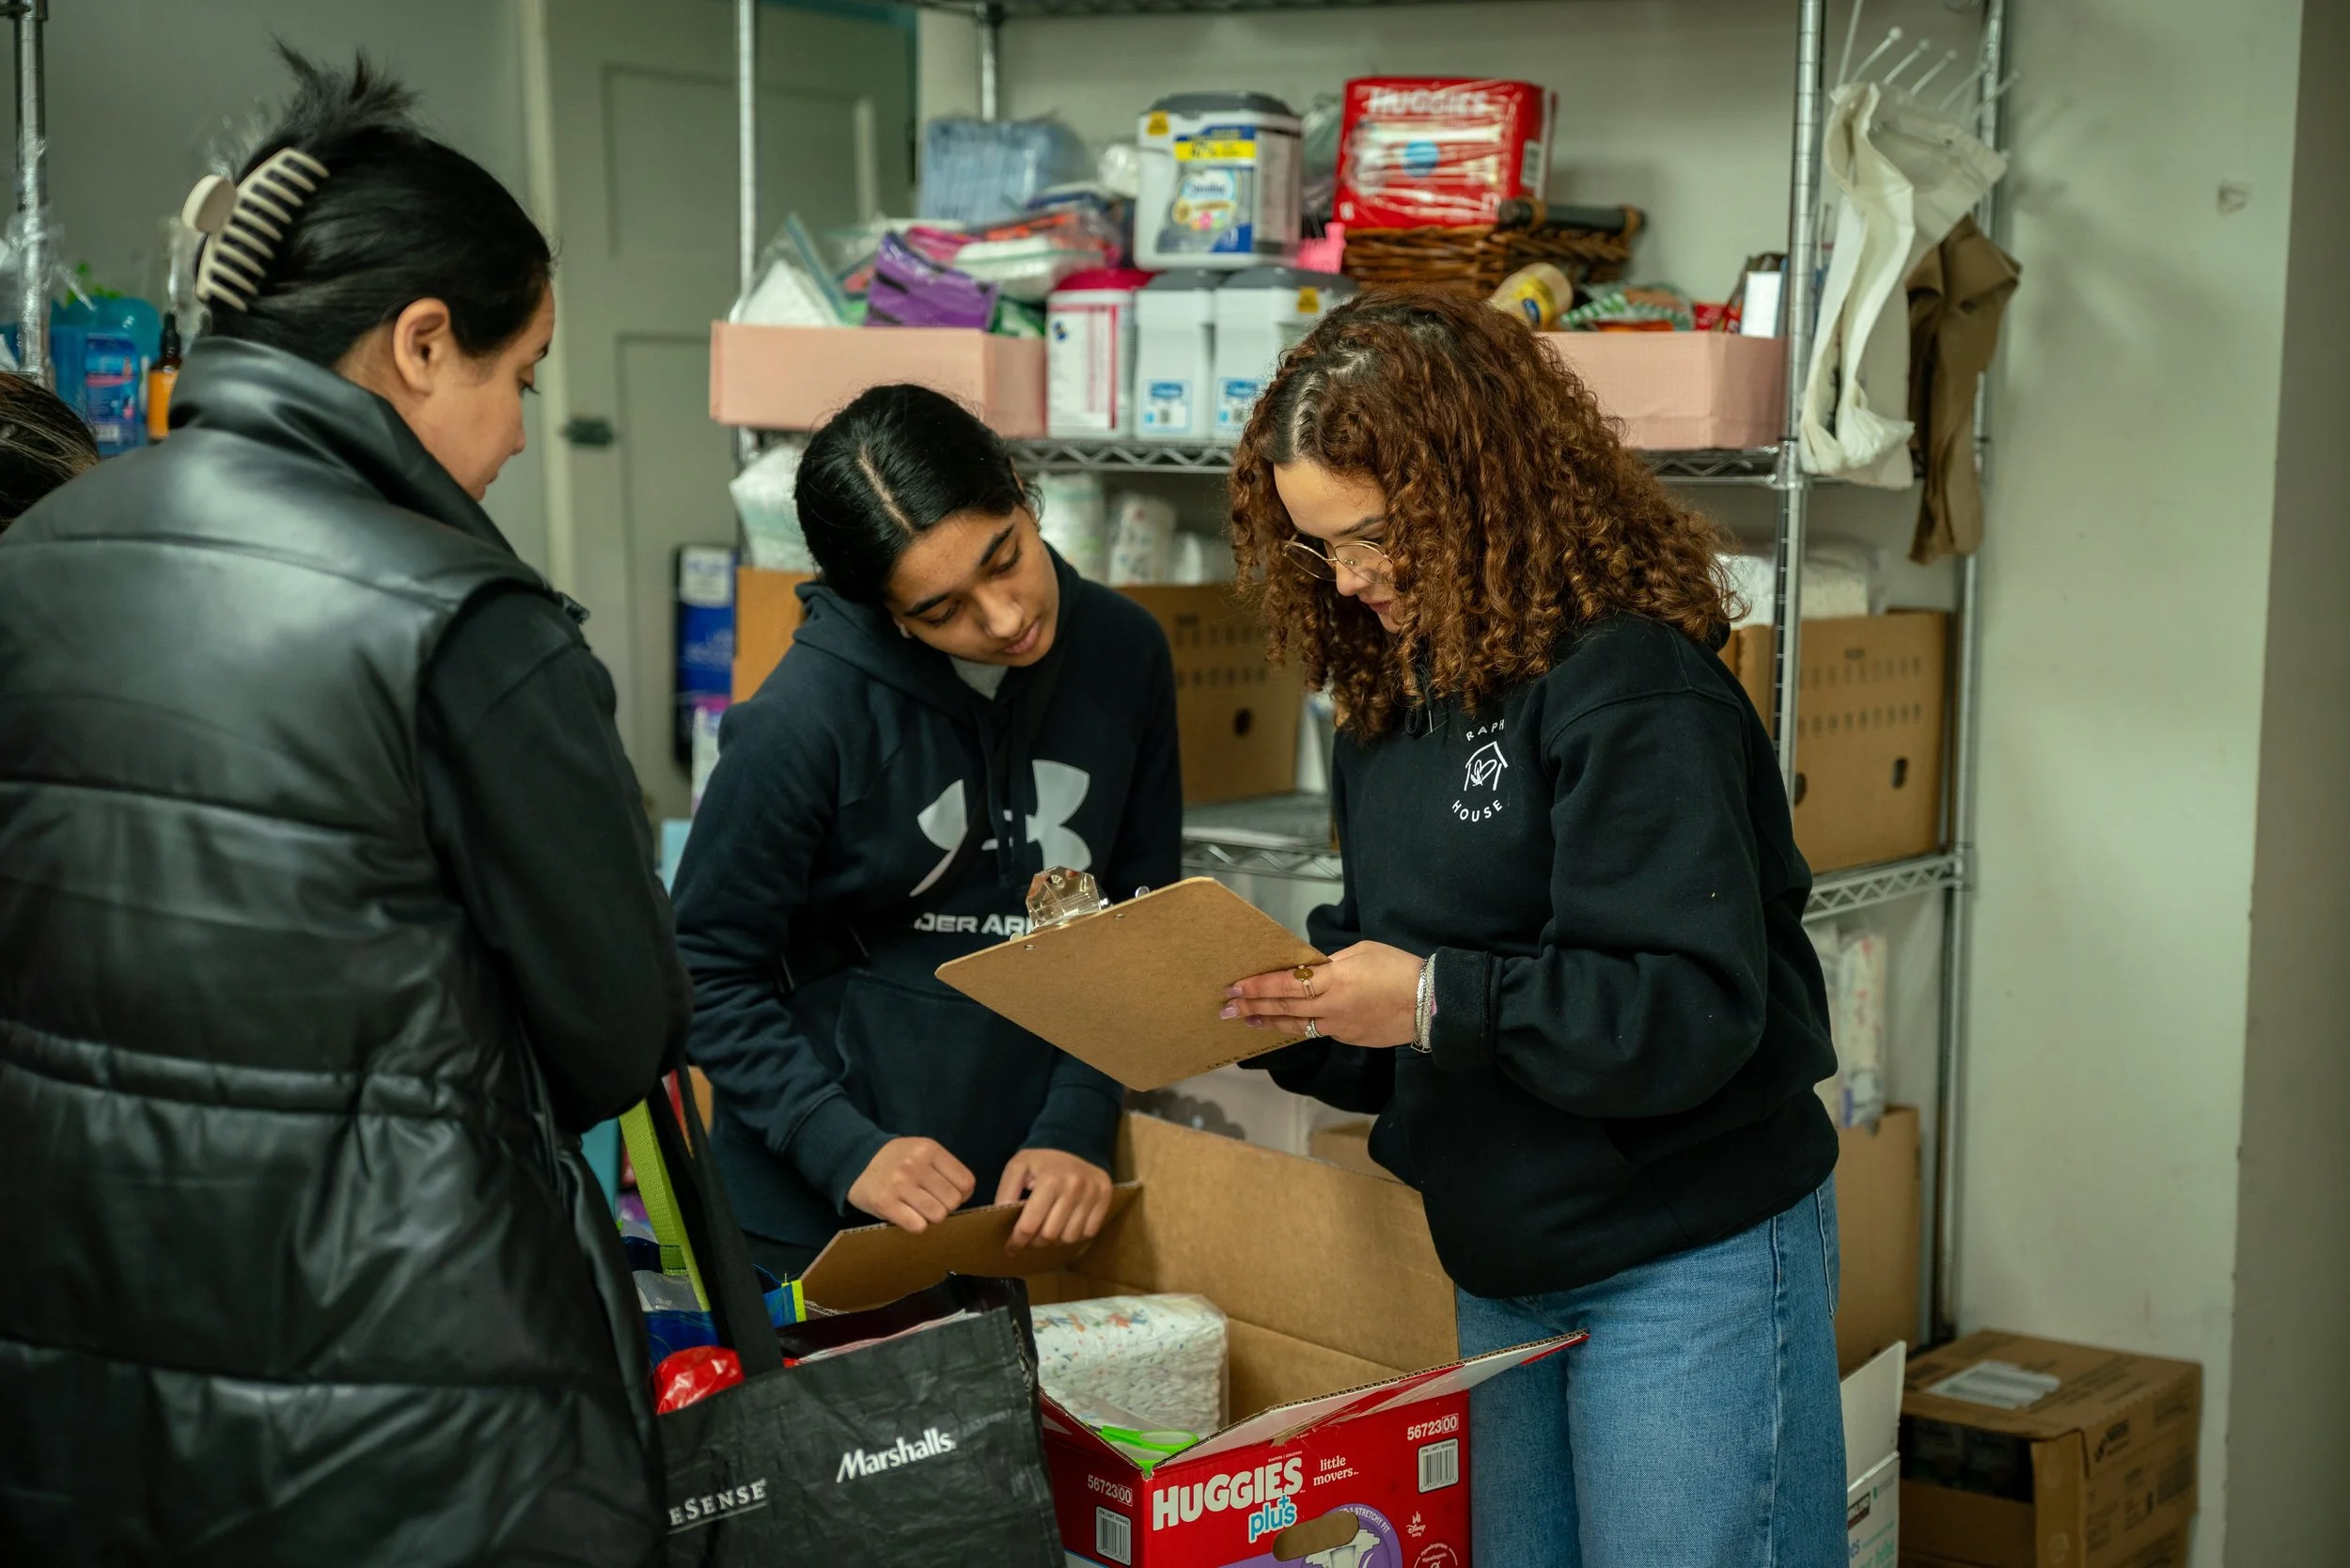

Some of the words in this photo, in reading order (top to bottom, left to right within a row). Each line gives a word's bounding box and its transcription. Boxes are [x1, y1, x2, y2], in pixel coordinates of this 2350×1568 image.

[1465, 719, 1505, 742] RAPH
[1451, 799, 1503, 823] HOUSE
[1407, 1414, 1458, 1441] 5672300
[837, 1427, 957, 1483] Marshalls
[1320, 1455, 1346, 1472] little
[1313, 1466, 1354, 1486] movers
[1152, 1457, 1304, 1531] HUGGIES
[1248, 1495, 1298, 1544] plus
[1355, 1507, 1383, 1526] STRETCHY
[1380, 1522, 1390, 1533] FIT
